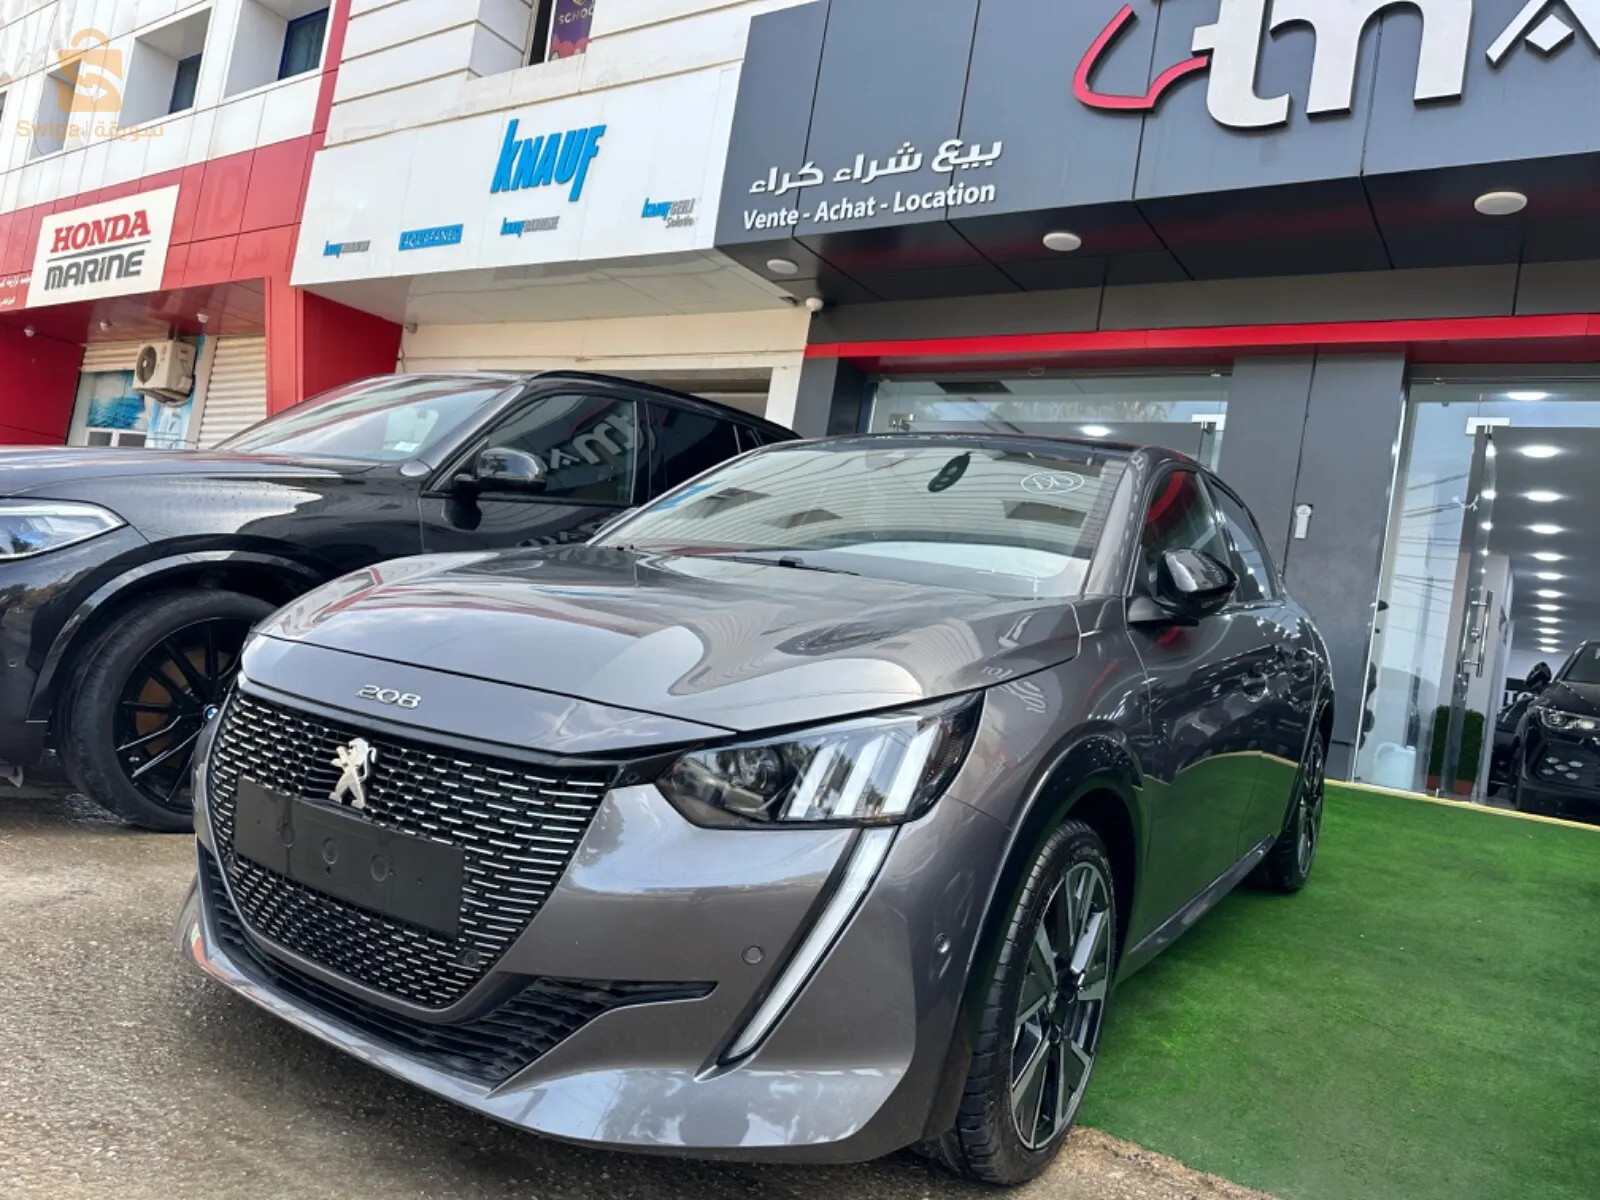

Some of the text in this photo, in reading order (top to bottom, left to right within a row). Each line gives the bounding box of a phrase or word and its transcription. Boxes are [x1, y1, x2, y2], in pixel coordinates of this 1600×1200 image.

[749, 138, 1003, 195] بيع شراء كراء
[743, 208, 799, 230] Vente
[814, 197, 877, 223] Achat
[893, 182, 996, 214] Location
[51, 209, 151, 254] HONDA
[44, 249, 145, 291] MARINE
[354, 683, 422, 710] 208
